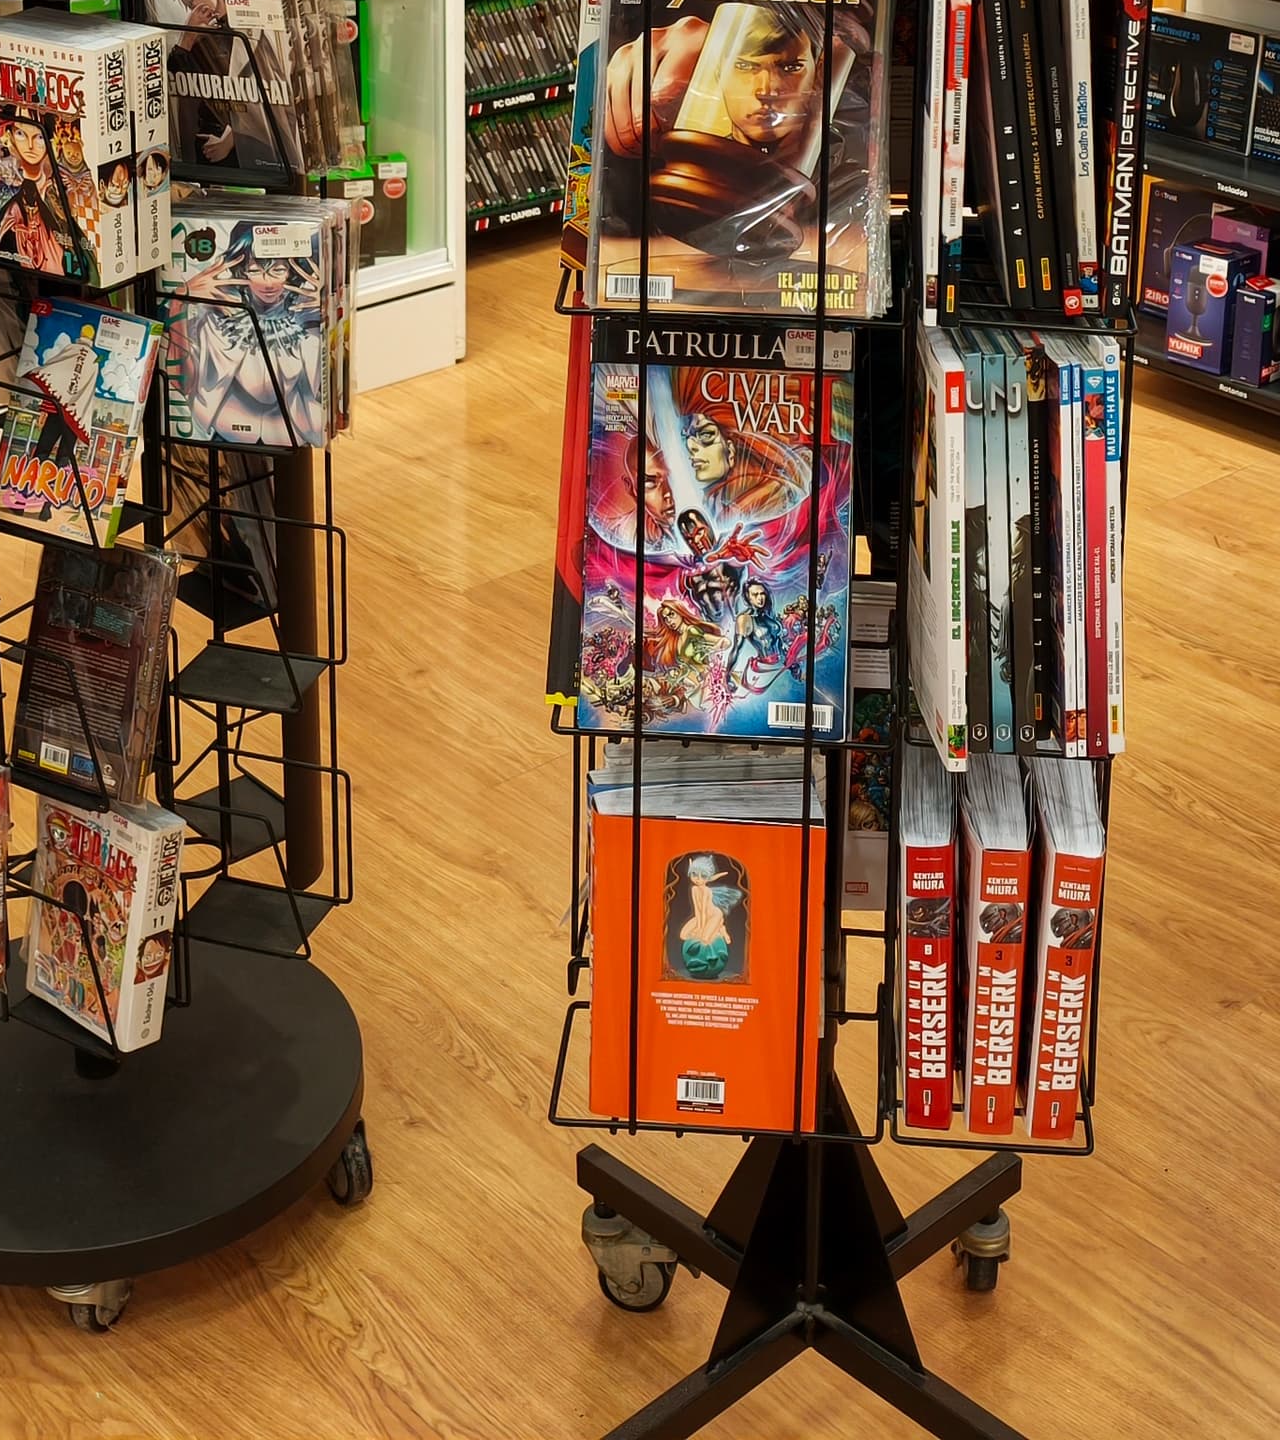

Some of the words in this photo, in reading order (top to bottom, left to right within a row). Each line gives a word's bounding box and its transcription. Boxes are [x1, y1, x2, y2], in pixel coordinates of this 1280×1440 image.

[1121, 19, 1140, 146] DETECTIVE
[1110, 153, 1134, 275] BATMAN
[189, 239, 213, 253] 18
[1168, 338, 1201, 357] YUNIX
[700, 372, 793, 405] CIVIL
[1107, 374, 1116, 456] MUST-HAVE
[733, 402, 807, 435] WAR
[3, 454, 104, 511] NARUTO
[913, 878, 944, 890] MIURA
[986, 884, 1018, 896] MIURA
[922, 962, 947, 1079] BERSERK
[988, 968, 1017, 1085] BERSERK
[1052, 973, 1085, 1091] BERSERK
